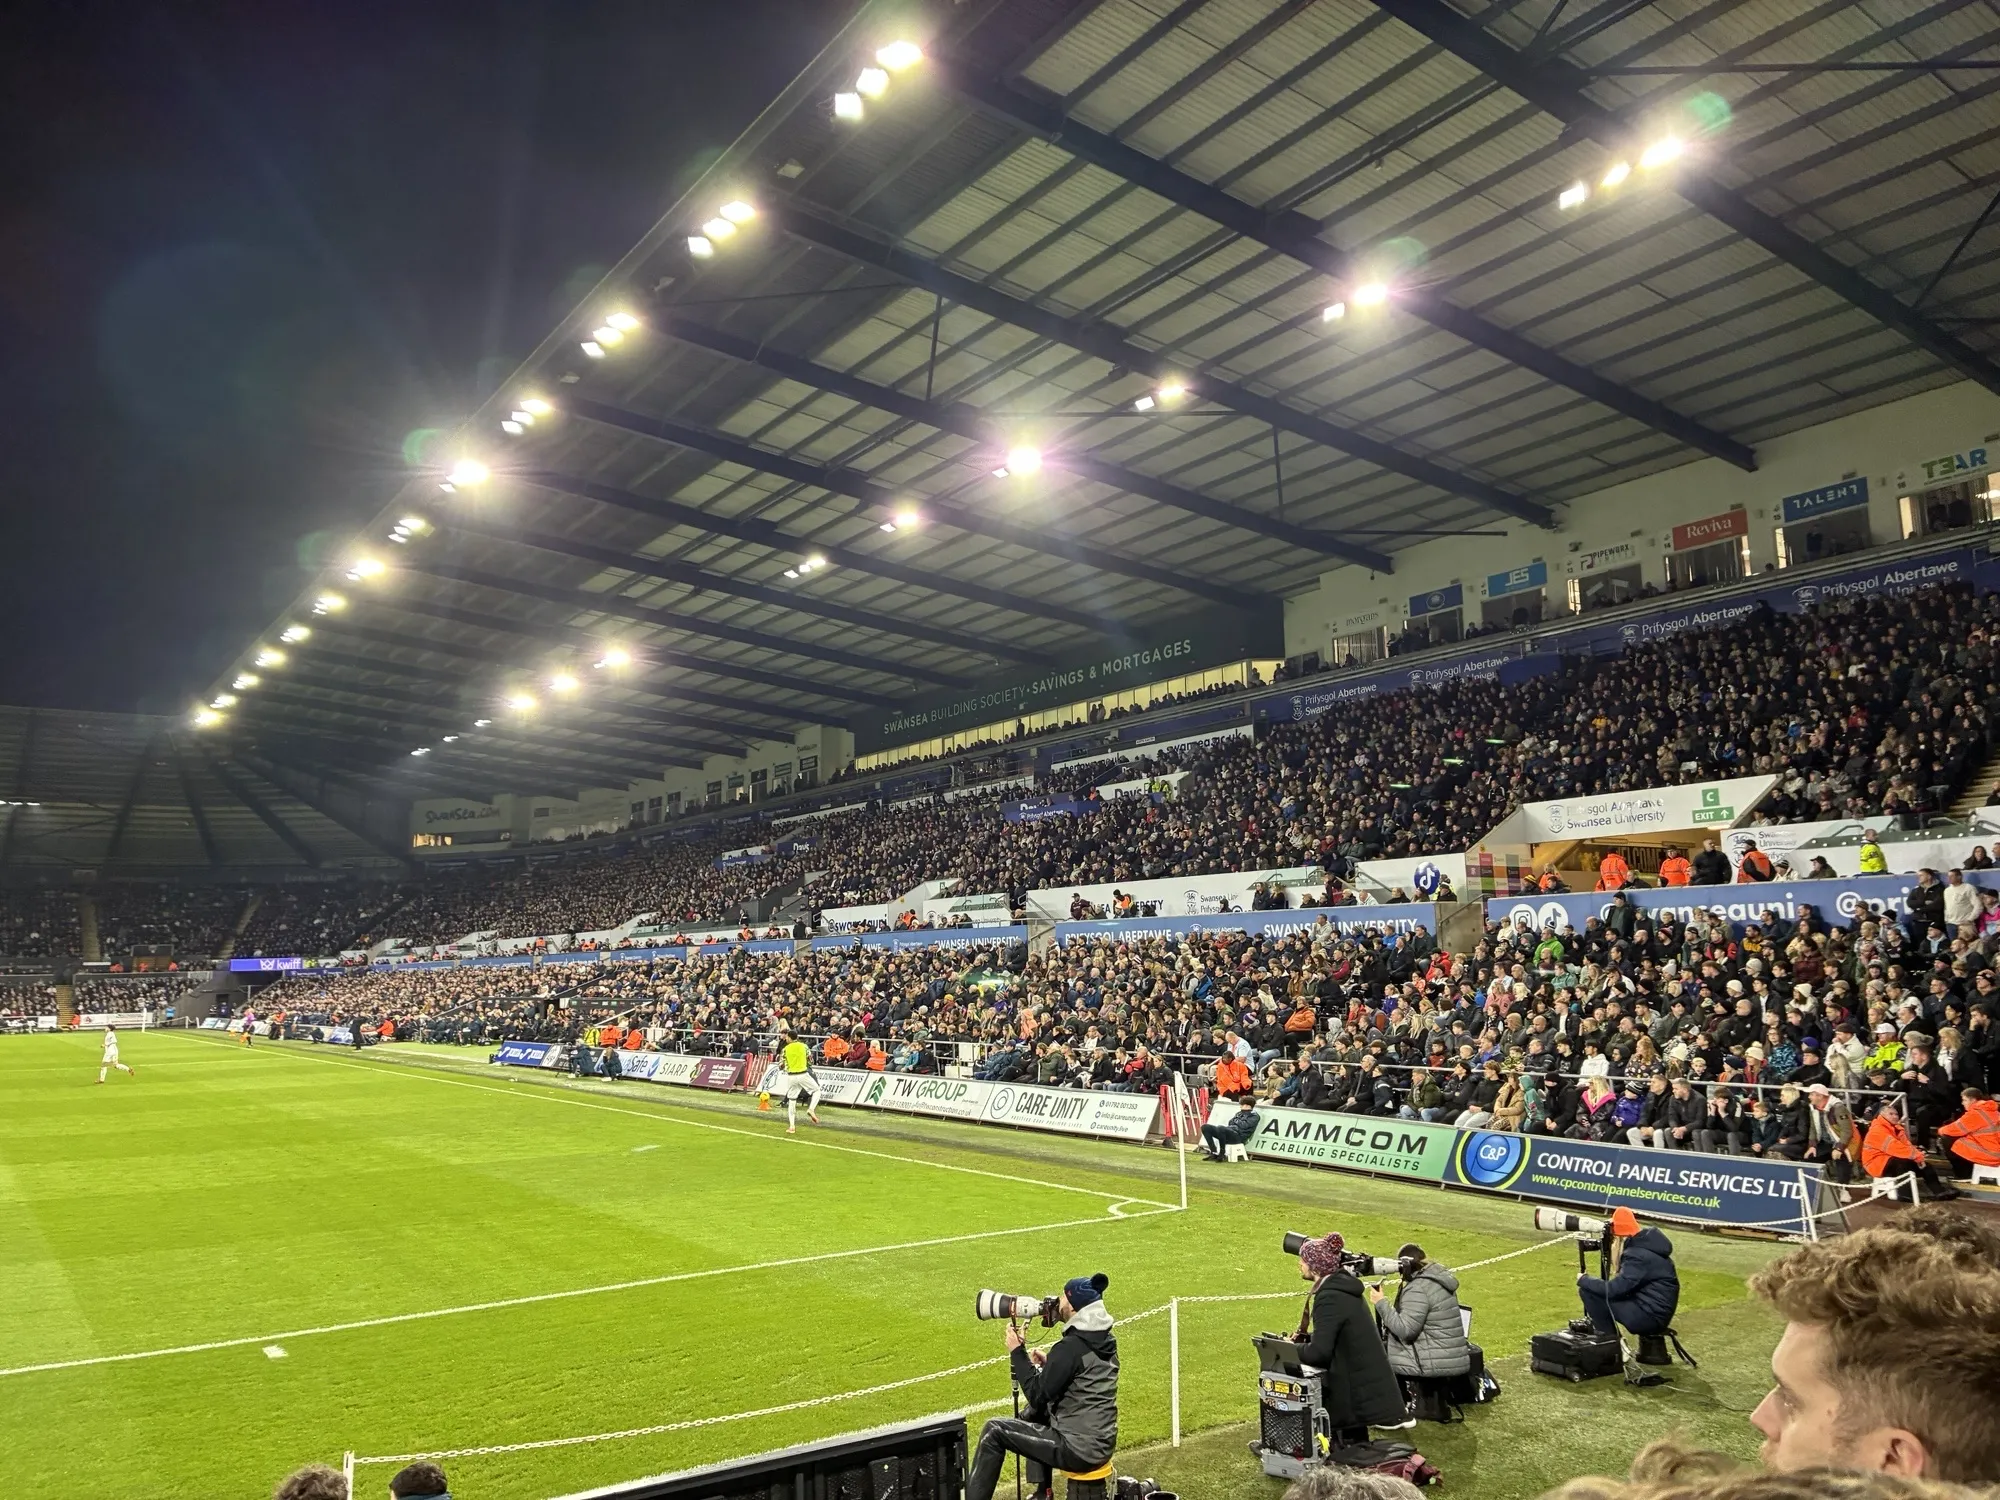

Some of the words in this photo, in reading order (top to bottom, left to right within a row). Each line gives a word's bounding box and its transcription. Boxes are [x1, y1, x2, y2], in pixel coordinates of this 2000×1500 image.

[1793, 484, 1857, 509] TALENT
[1687, 518, 1732, 538] Reviva
[1822, 575, 1880, 598] Prifysgol
[1883, 561, 1958, 586] Abertawe
[1642, 616, 1689, 636] Prifysgol
[1692, 604, 1753, 626] Abertawe
[1425, 665, 1462, 682] Prifysgol
[883, 714, 929, 735] SWANSEA
[930, 699, 978, 723] BUILDING
[980, 684, 1026, 709] SOCIETY
[1031, 668, 1085, 695] SAVINGS
[1089, 666, 1097, 679] &
[1102, 639, 1192, 676] MORTGAGES
[1305, 690, 1337, 706] Prifysgol
[1337, 682, 1377, 699] Abertawe
[1706, 791, 1715, 802] C
[1567, 817, 1612, 829] Swansea
[1615, 810, 1666, 825] University
[1695, 811, 1714, 821] EXIT
[1200, 894, 1226, 903] Swansea
[1118, 928, 1172, 944] ABERTAWE
[276, 959, 301, 970] kwiff
[893, 1078, 918, 1097] TW
[916, 1079, 968, 1102] GROUP
[1016, 1091, 1052, 1116] CARE
[1049, 1096, 1089, 1120] UNITY
[1261, 1118, 1429, 1156] AMMCOM
[1255, 1139, 1265, 1150] IT
[1271, 1141, 1325, 1157] CABLING
[1330, 1149, 1421, 1171] SPECIALISTS
[1479, 1144, 1507, 1162] C&P
[1536, 1152, 1614, 1178] CONTROL
[1617, 1162, 1674, 1186] PANEL
[1677, 1170, 1765, 1196] SERVICES
[1767, 1179, 1805, 1200] LTD
[1531, 1173, 1720, 1209] www.cpcontrolpanelservices.co.uk
